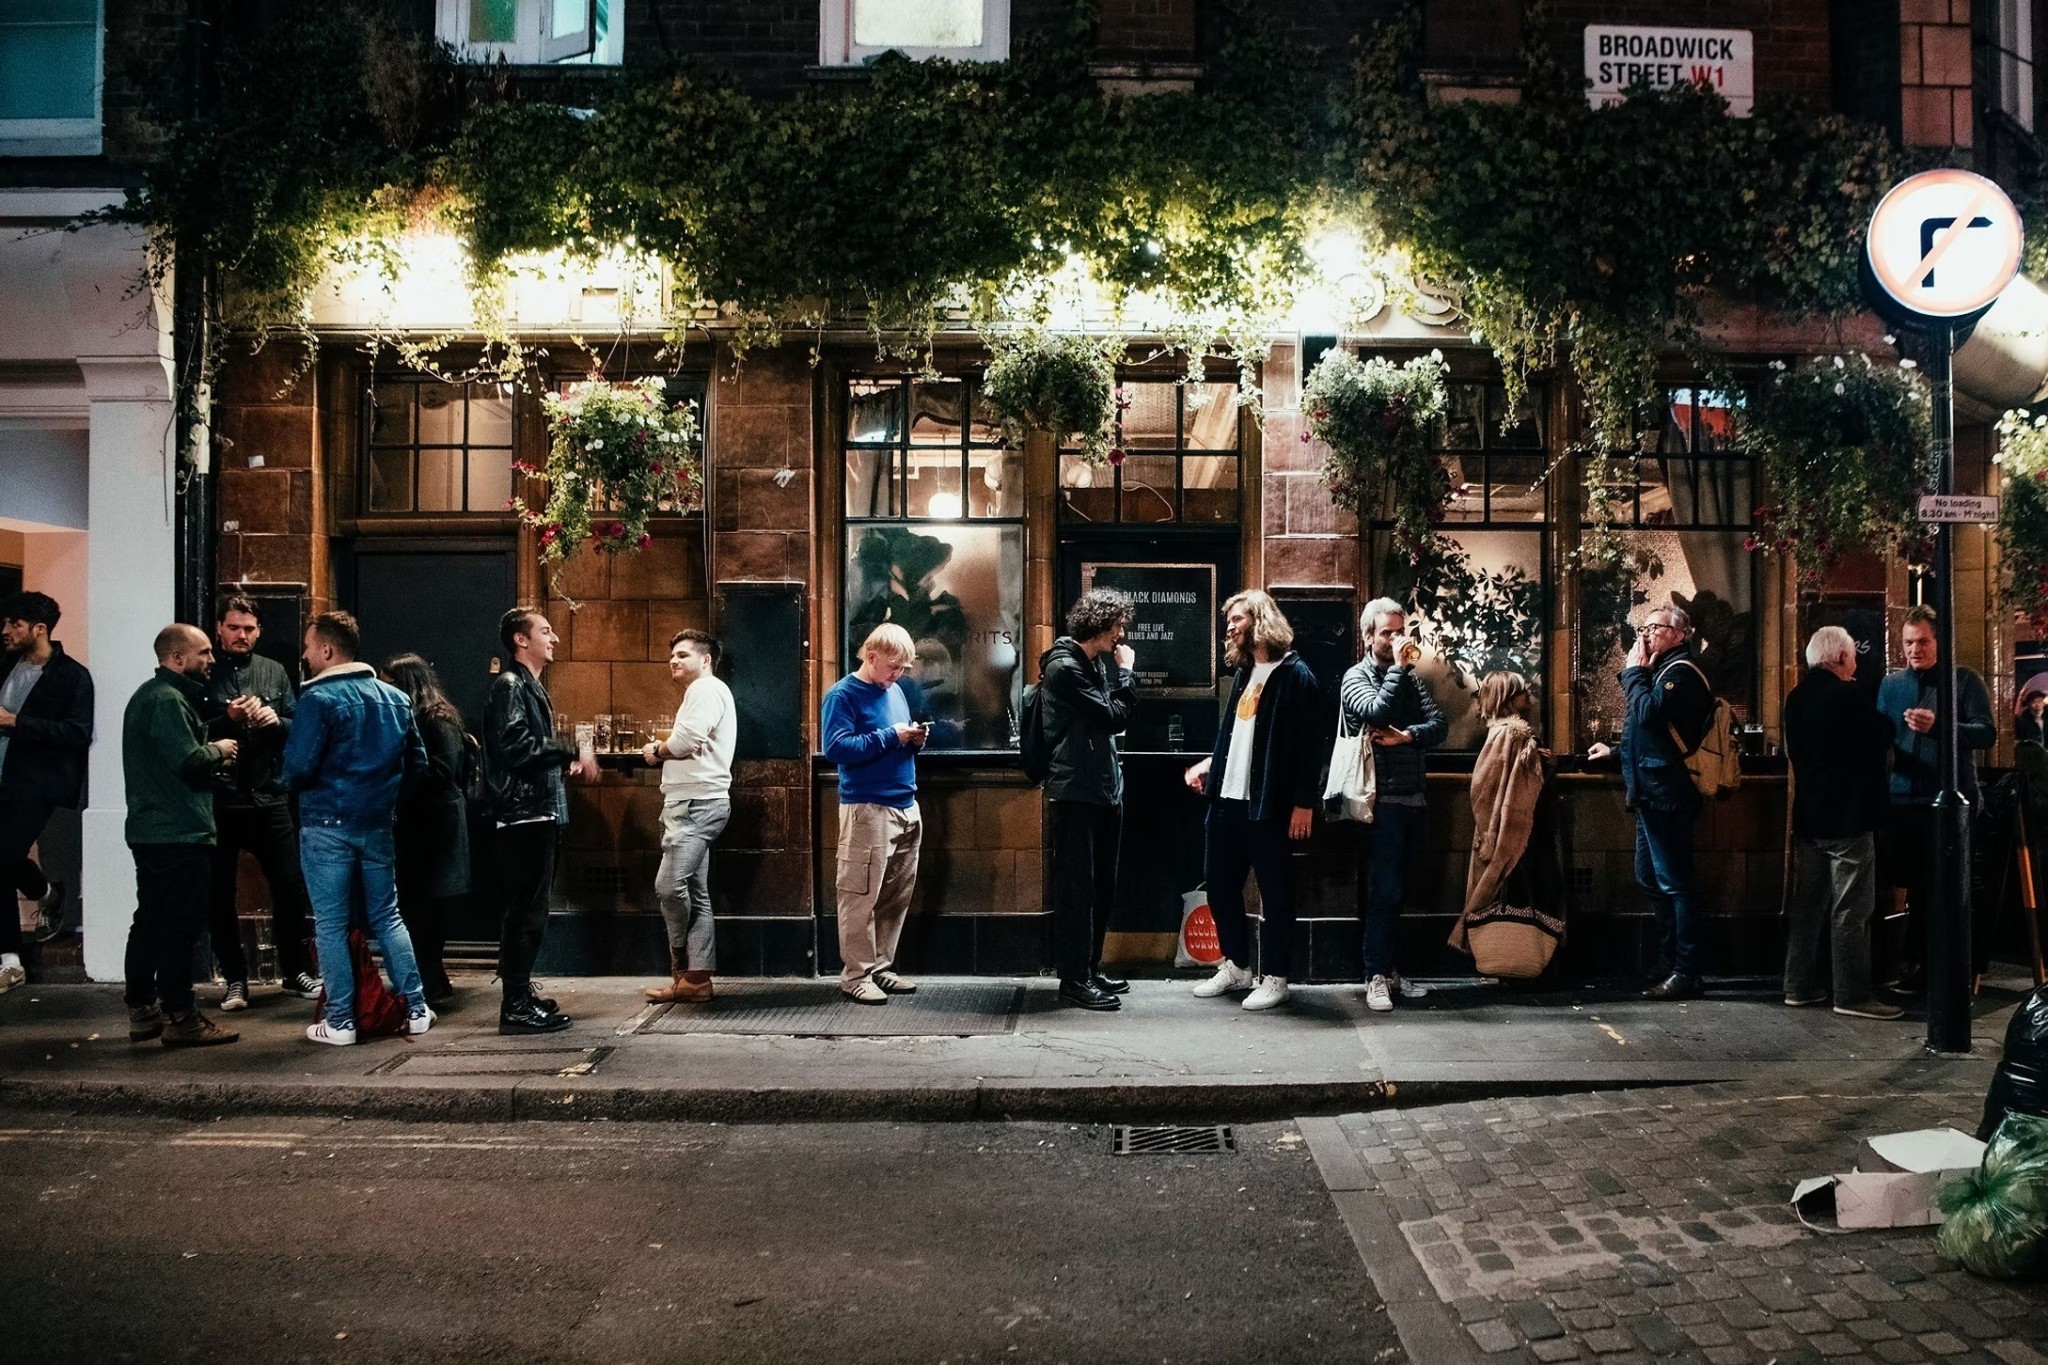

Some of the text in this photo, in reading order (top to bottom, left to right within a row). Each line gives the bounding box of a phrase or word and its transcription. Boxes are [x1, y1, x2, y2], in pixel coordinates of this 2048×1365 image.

[1599, 34, 1734, 60] BROADWICK
[1599, 62, 1724, 88] STREET W1
[1935, 499, 1982, 509] No loading
[1123, 591, 1197, 604] BLACK DIAMONDS
[1137, 623, 1165, 632] FREE LIVE
[1127, 632, 1174, 640] BLUES AND JAZZ
[1188, 927, 1217, 937] RECOR
[1189, 940, 1220, 950] LONDO
